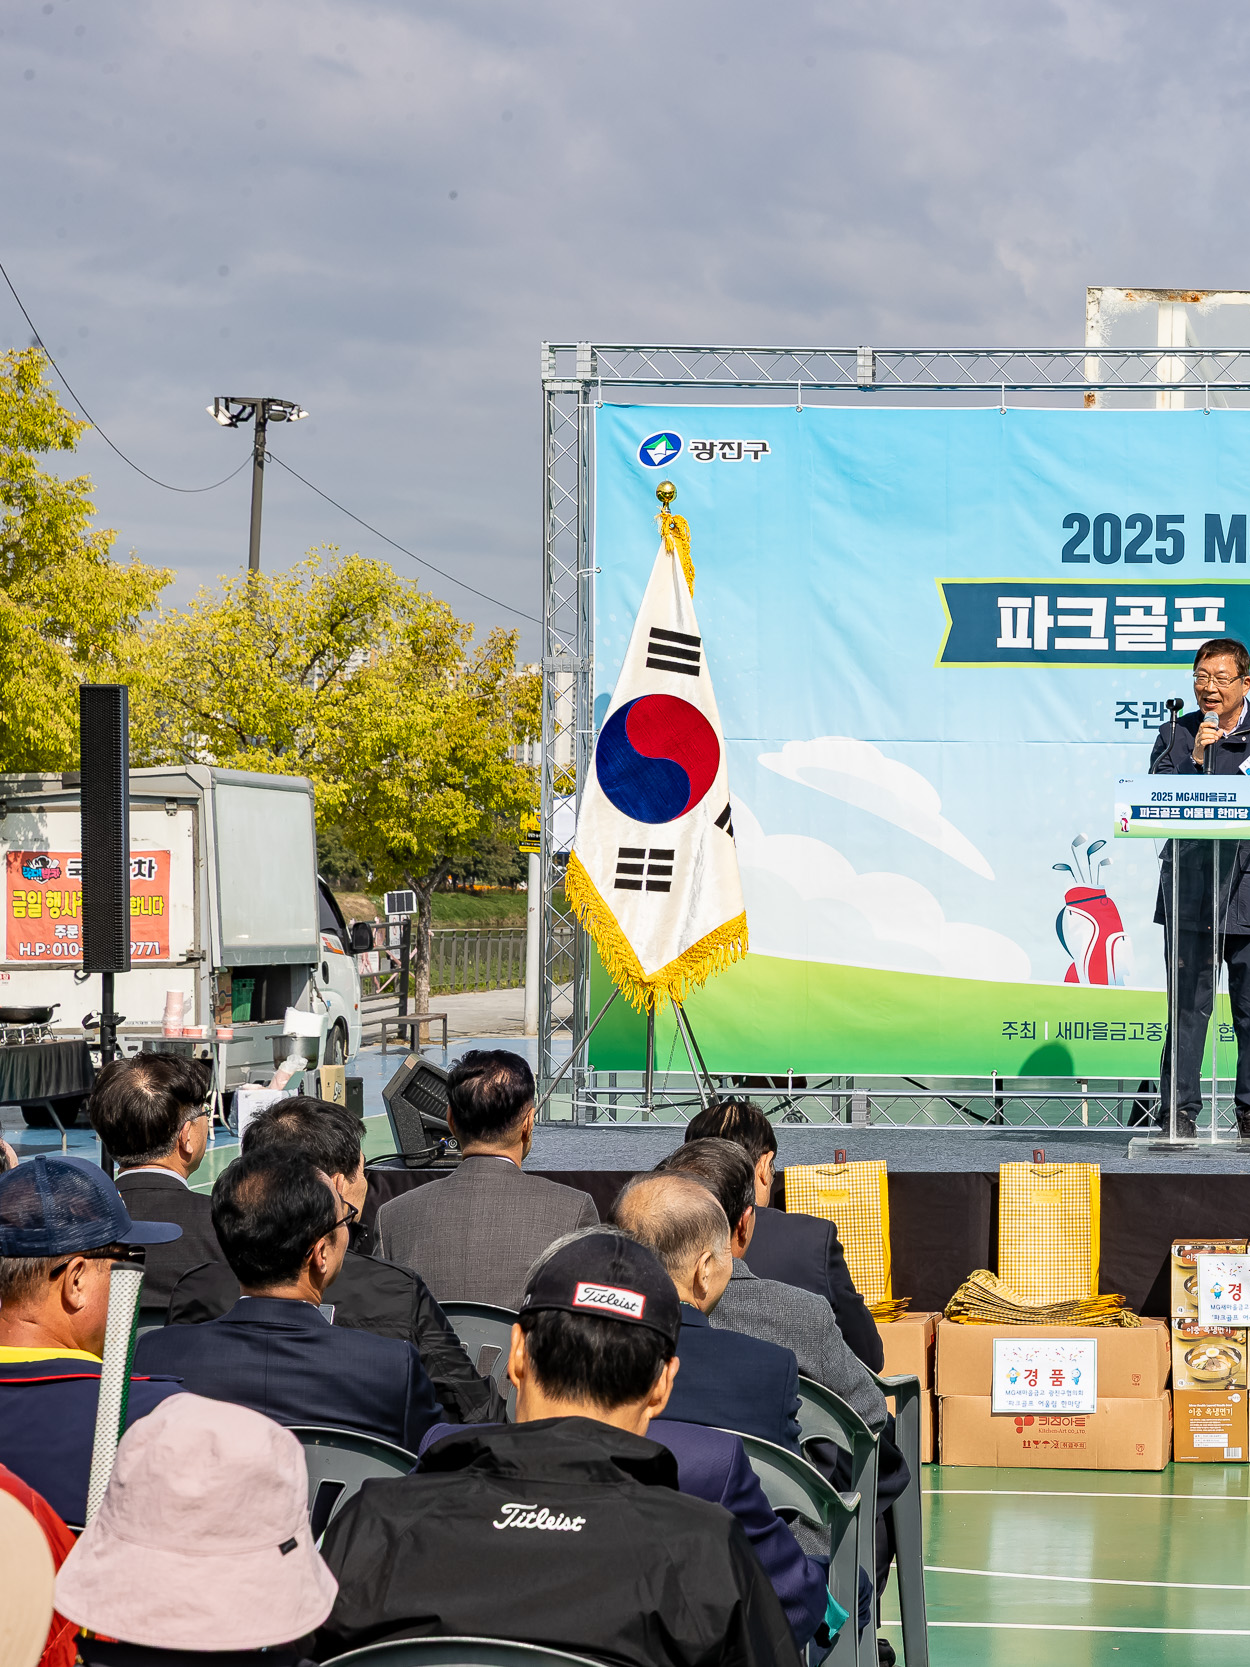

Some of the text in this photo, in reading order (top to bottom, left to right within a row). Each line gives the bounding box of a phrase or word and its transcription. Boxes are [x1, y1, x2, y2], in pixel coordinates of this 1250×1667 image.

[688, 440, 770, 461] 광진구
[1061, 512, 1186, 565] 2025
[995, 596, 1226, 652] 파크골프
[1114, 701, 1168, 729] 주관
[1151, 792, 1237, 802] 2025 MG새마을금고
[1139, 807, 1249, 819] 파크골프 어울림 한마당
[12, 890, 42, 918] 금일
[45, 890, 83, 919] 행사
[54, 925, 79, 938] 주문
[1001, 1021, 1037, 1040] 주최
[577, 1287, 640, 1312] Titleist
[1186, 1326, 1200, 1335] 이중
[1188, 1408, 1202, 1416] 이중
[492, 1503, 587, 1532] Titleist
